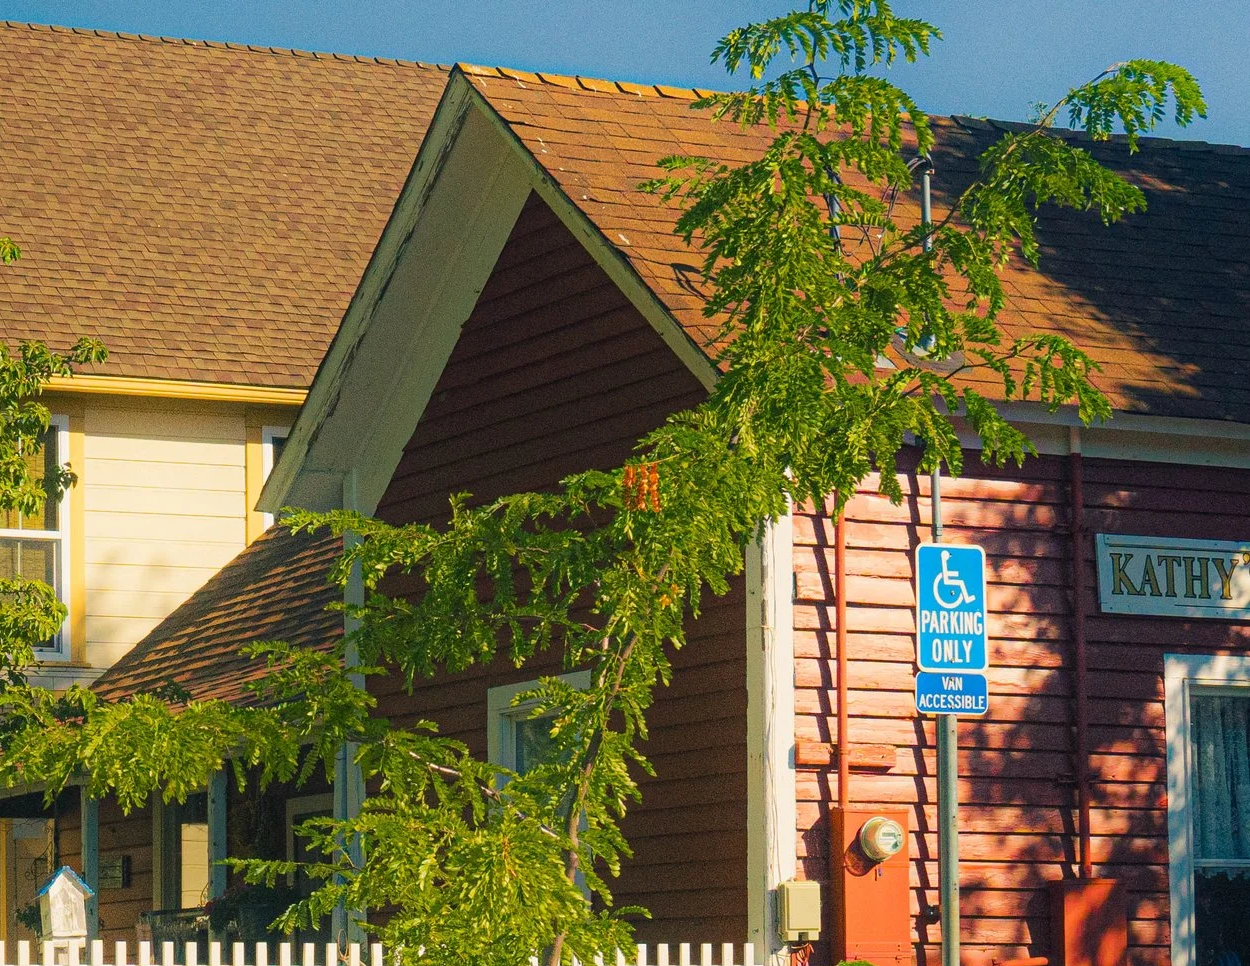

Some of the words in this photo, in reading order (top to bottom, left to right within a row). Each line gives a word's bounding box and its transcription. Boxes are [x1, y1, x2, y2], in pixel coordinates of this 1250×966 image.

[1109, 552, 1250, 600] KATHY'
[921, 610, 983, 635] PARKING
[931, 638, 973, 663] ONLY
[941, 676, 963, 691] VAN
[919, 693, 985, 710] ACCESSIBLE
